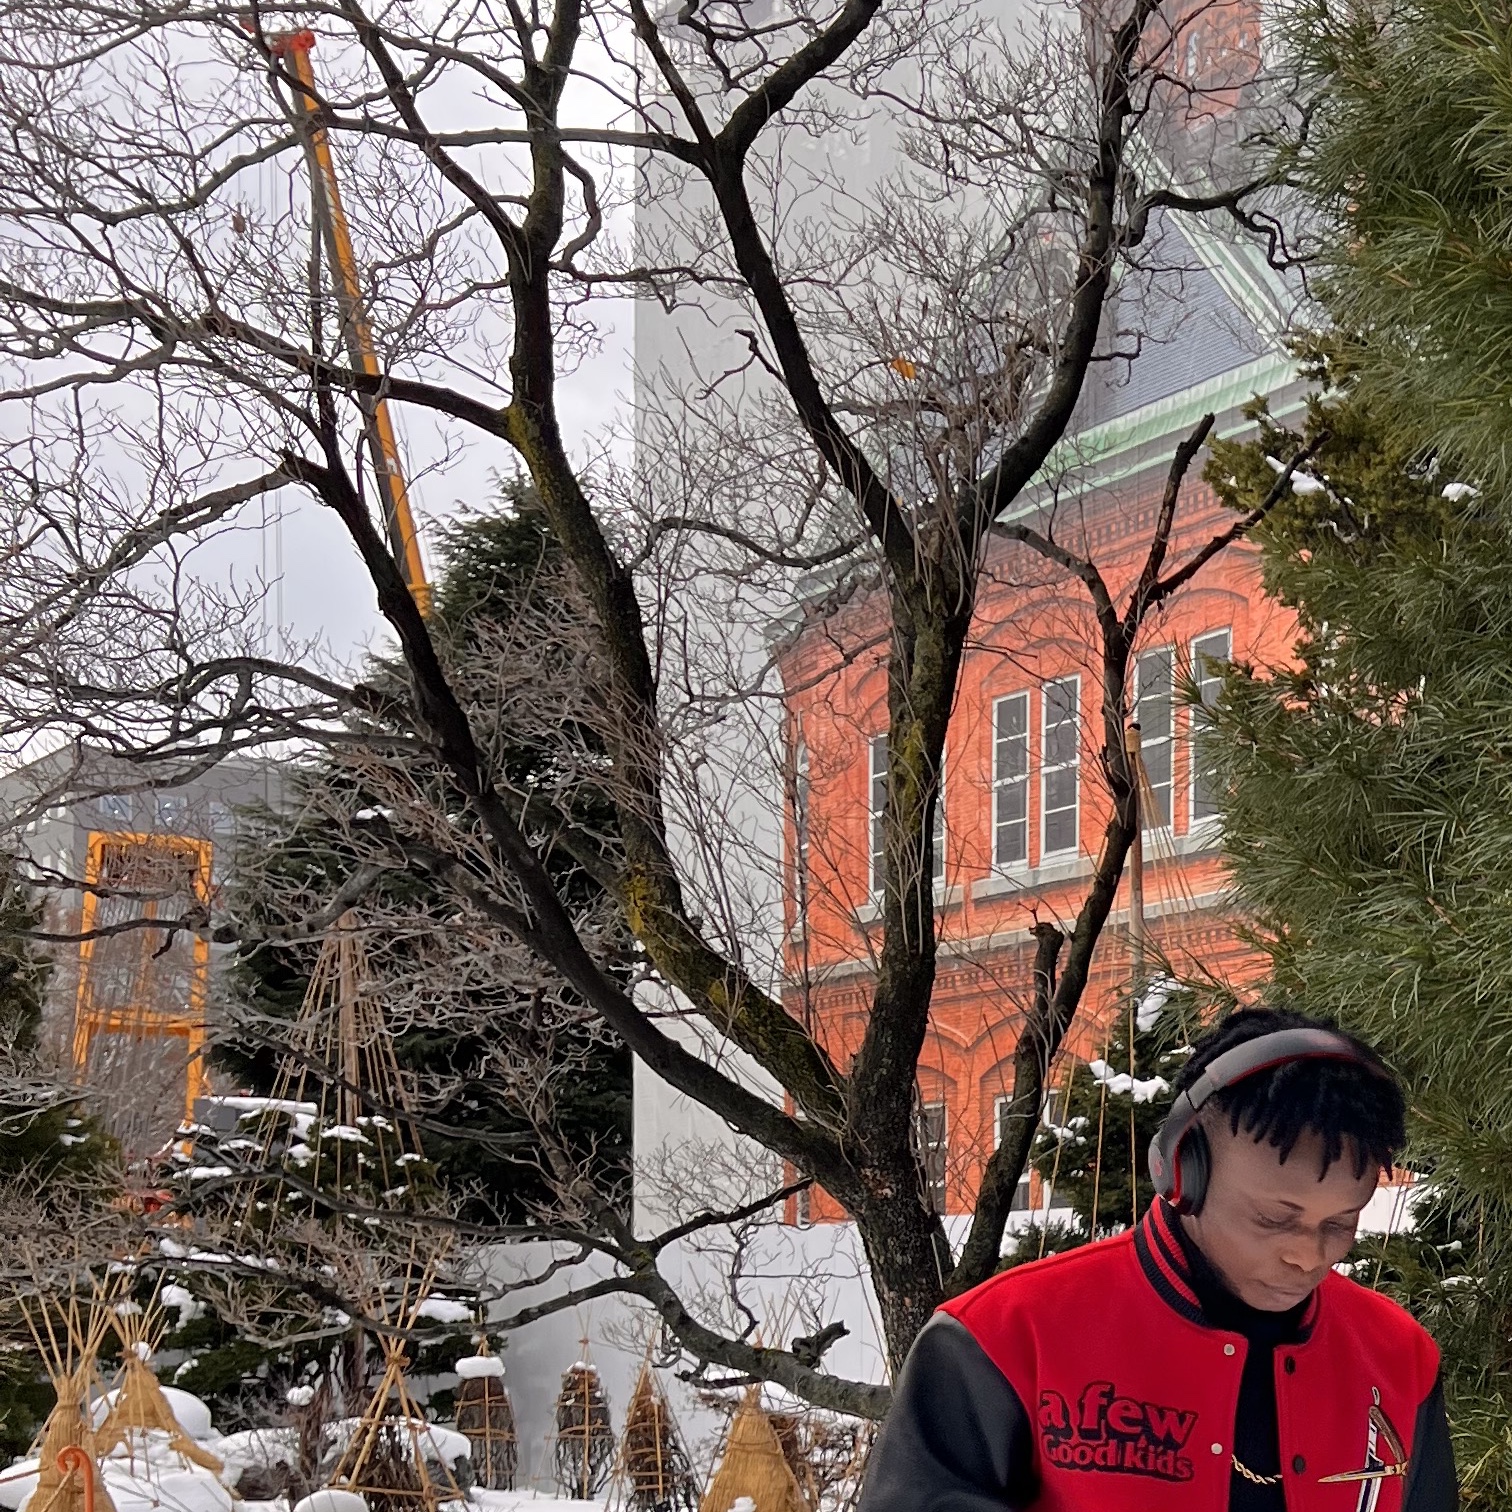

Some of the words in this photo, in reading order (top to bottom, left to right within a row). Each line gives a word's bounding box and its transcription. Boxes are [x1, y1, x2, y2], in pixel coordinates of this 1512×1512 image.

[1038, 1389, 1069, 1431] a
[1080, 1382, 1196, 1445] few
[1041, 1433, 1118, 1467] Good
